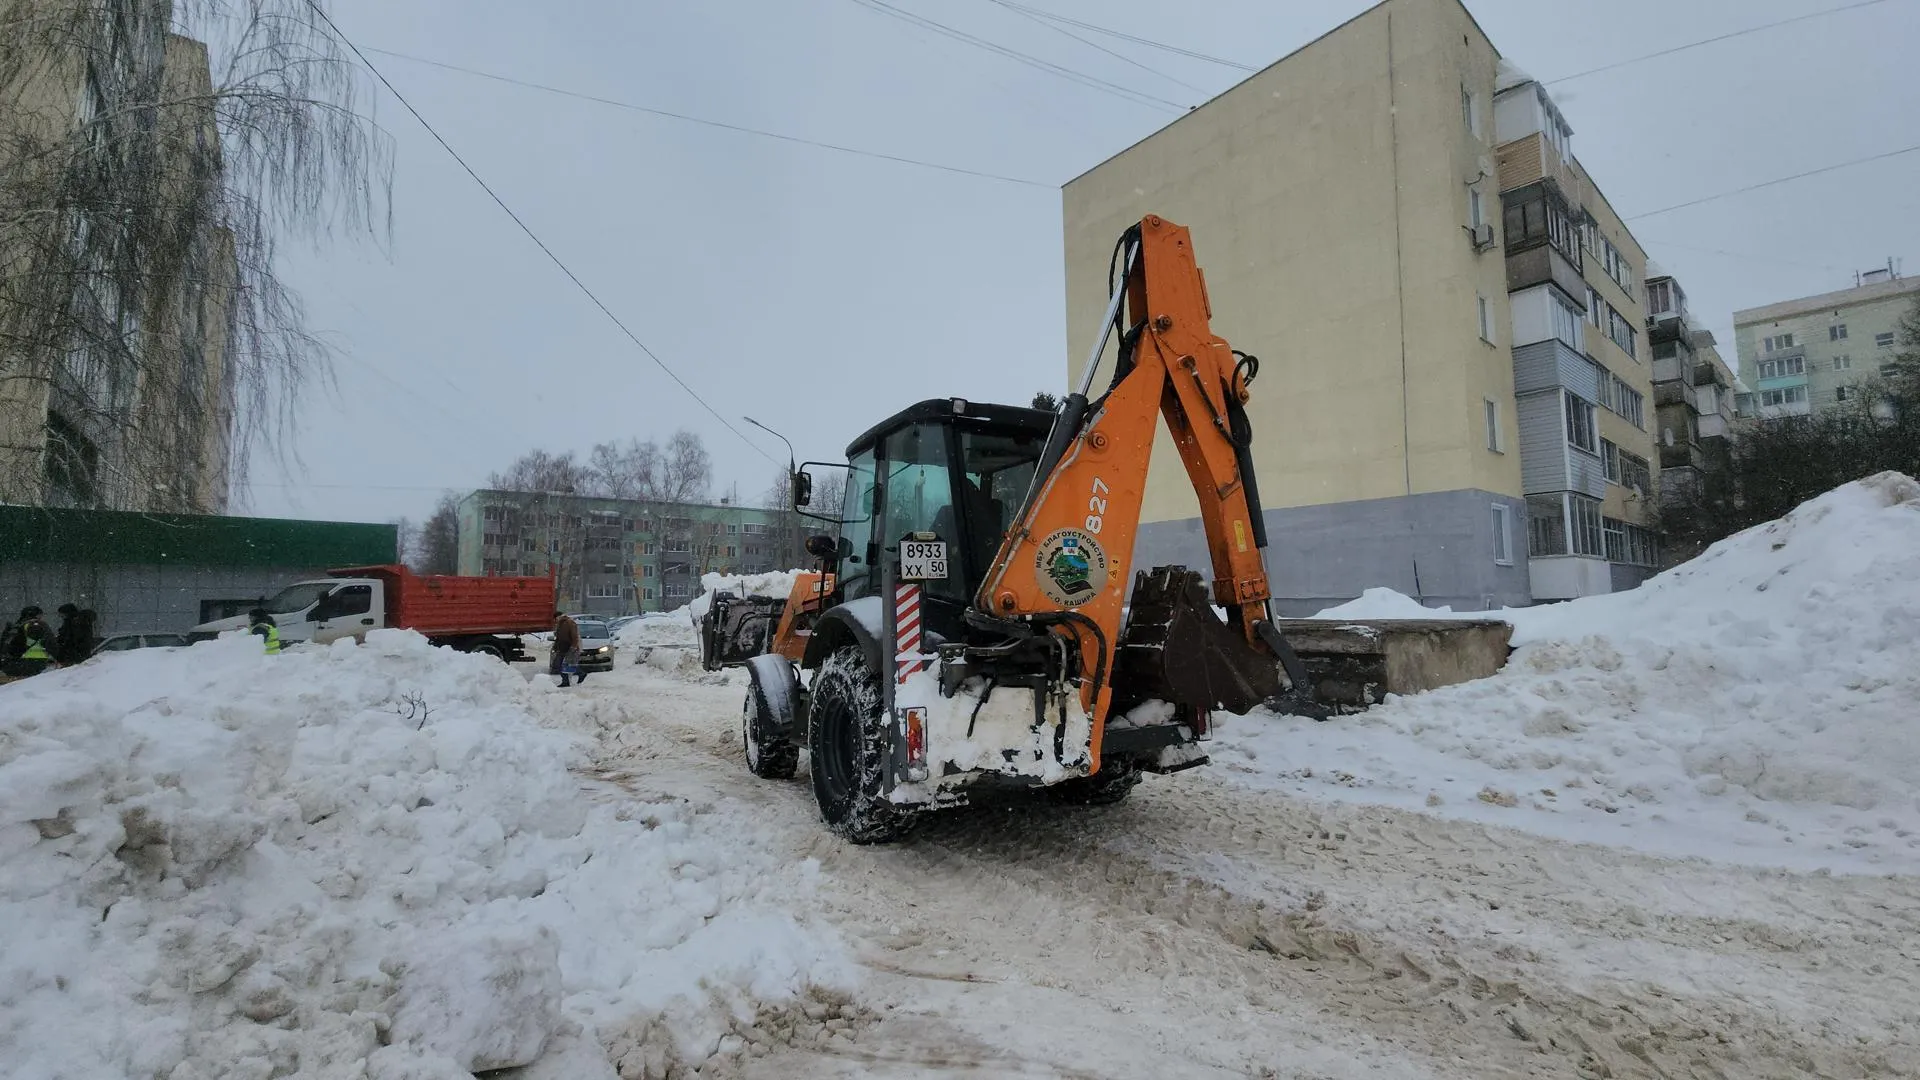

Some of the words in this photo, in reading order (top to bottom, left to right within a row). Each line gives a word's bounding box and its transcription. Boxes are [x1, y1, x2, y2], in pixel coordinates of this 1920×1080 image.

[1085, 477, 1109, 535] 827
[907, 544, 941, 558] 8933
[1035, 551, 1044, 568] МБУ
[1043, 531, 1105, 569] БЛАГОУСТРОЙСТВО
[931, 561, 945, 572] 50
[1064, 592, 1096, 606] КАШИРА
